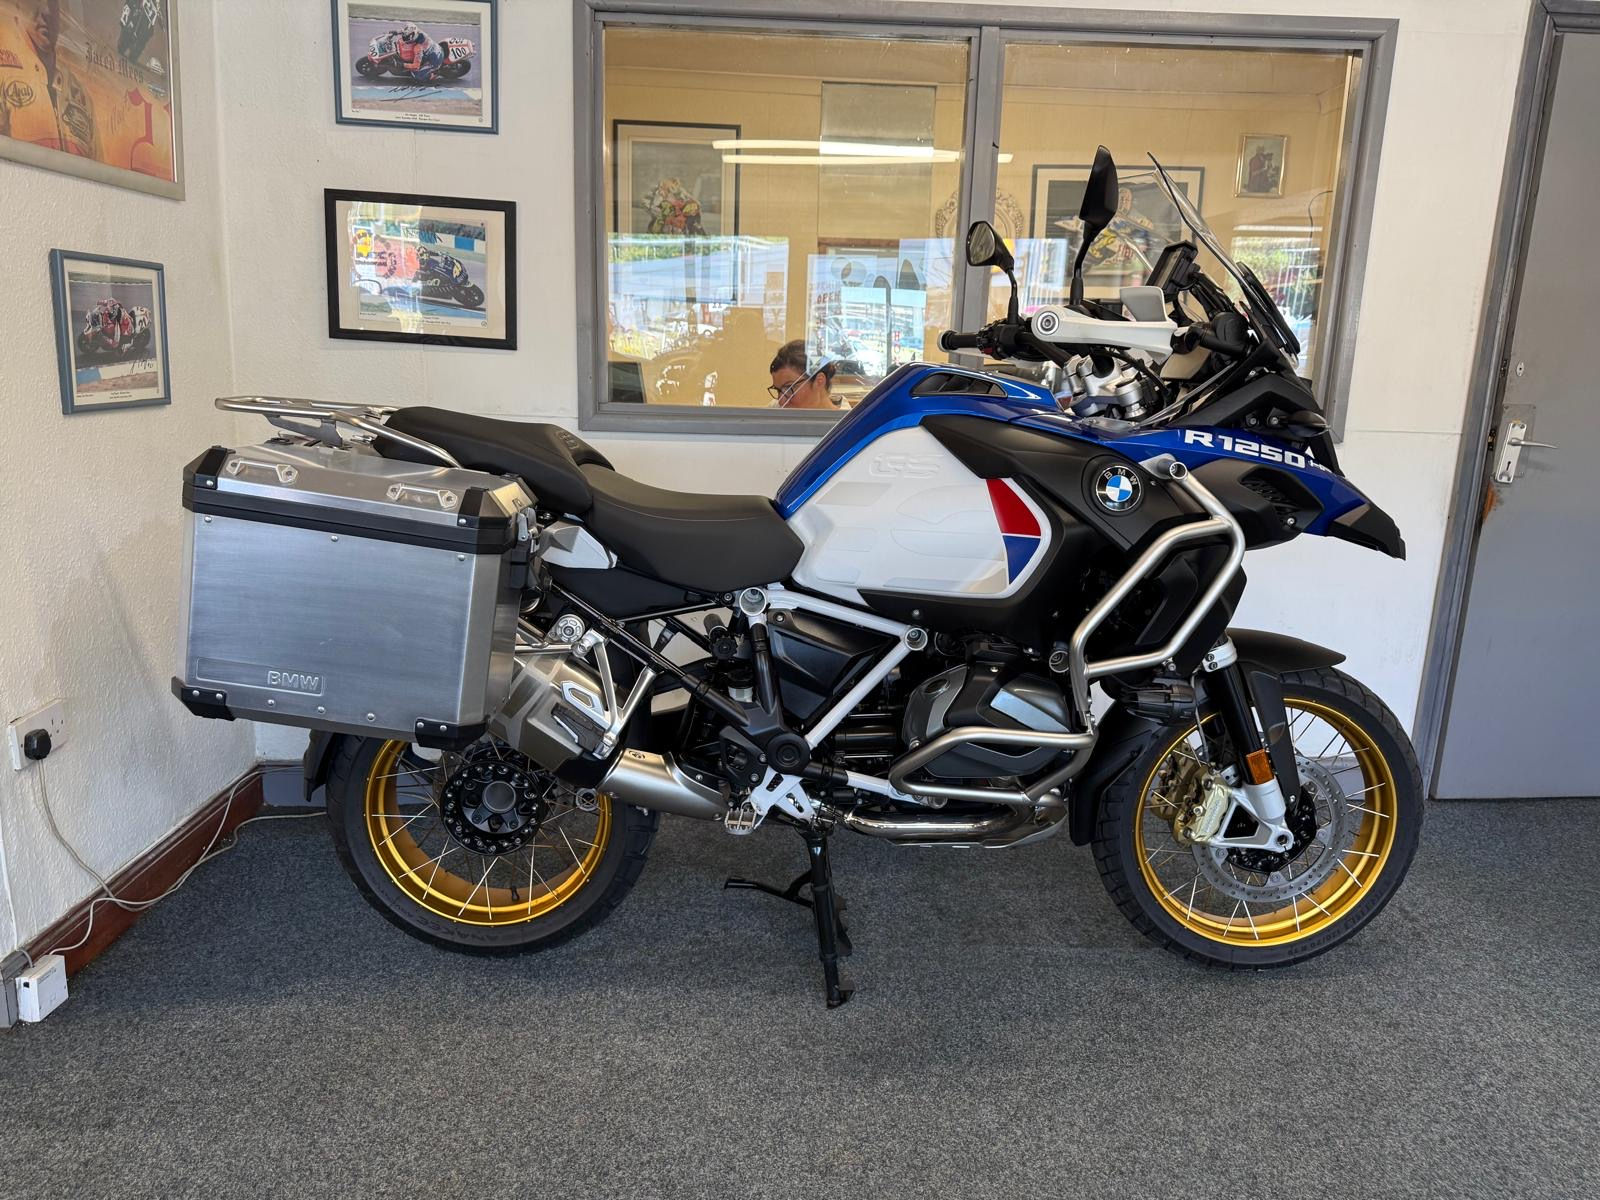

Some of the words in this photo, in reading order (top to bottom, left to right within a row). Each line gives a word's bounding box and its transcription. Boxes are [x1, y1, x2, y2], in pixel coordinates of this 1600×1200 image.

[450, 46, 467, 60] 100
[1184, 429, 1214, 448] R
[1218, 435, 1305, 469] 1250
[1104, 468, 1138, 485] BMW
[267, 670, 320, 691] BMW
